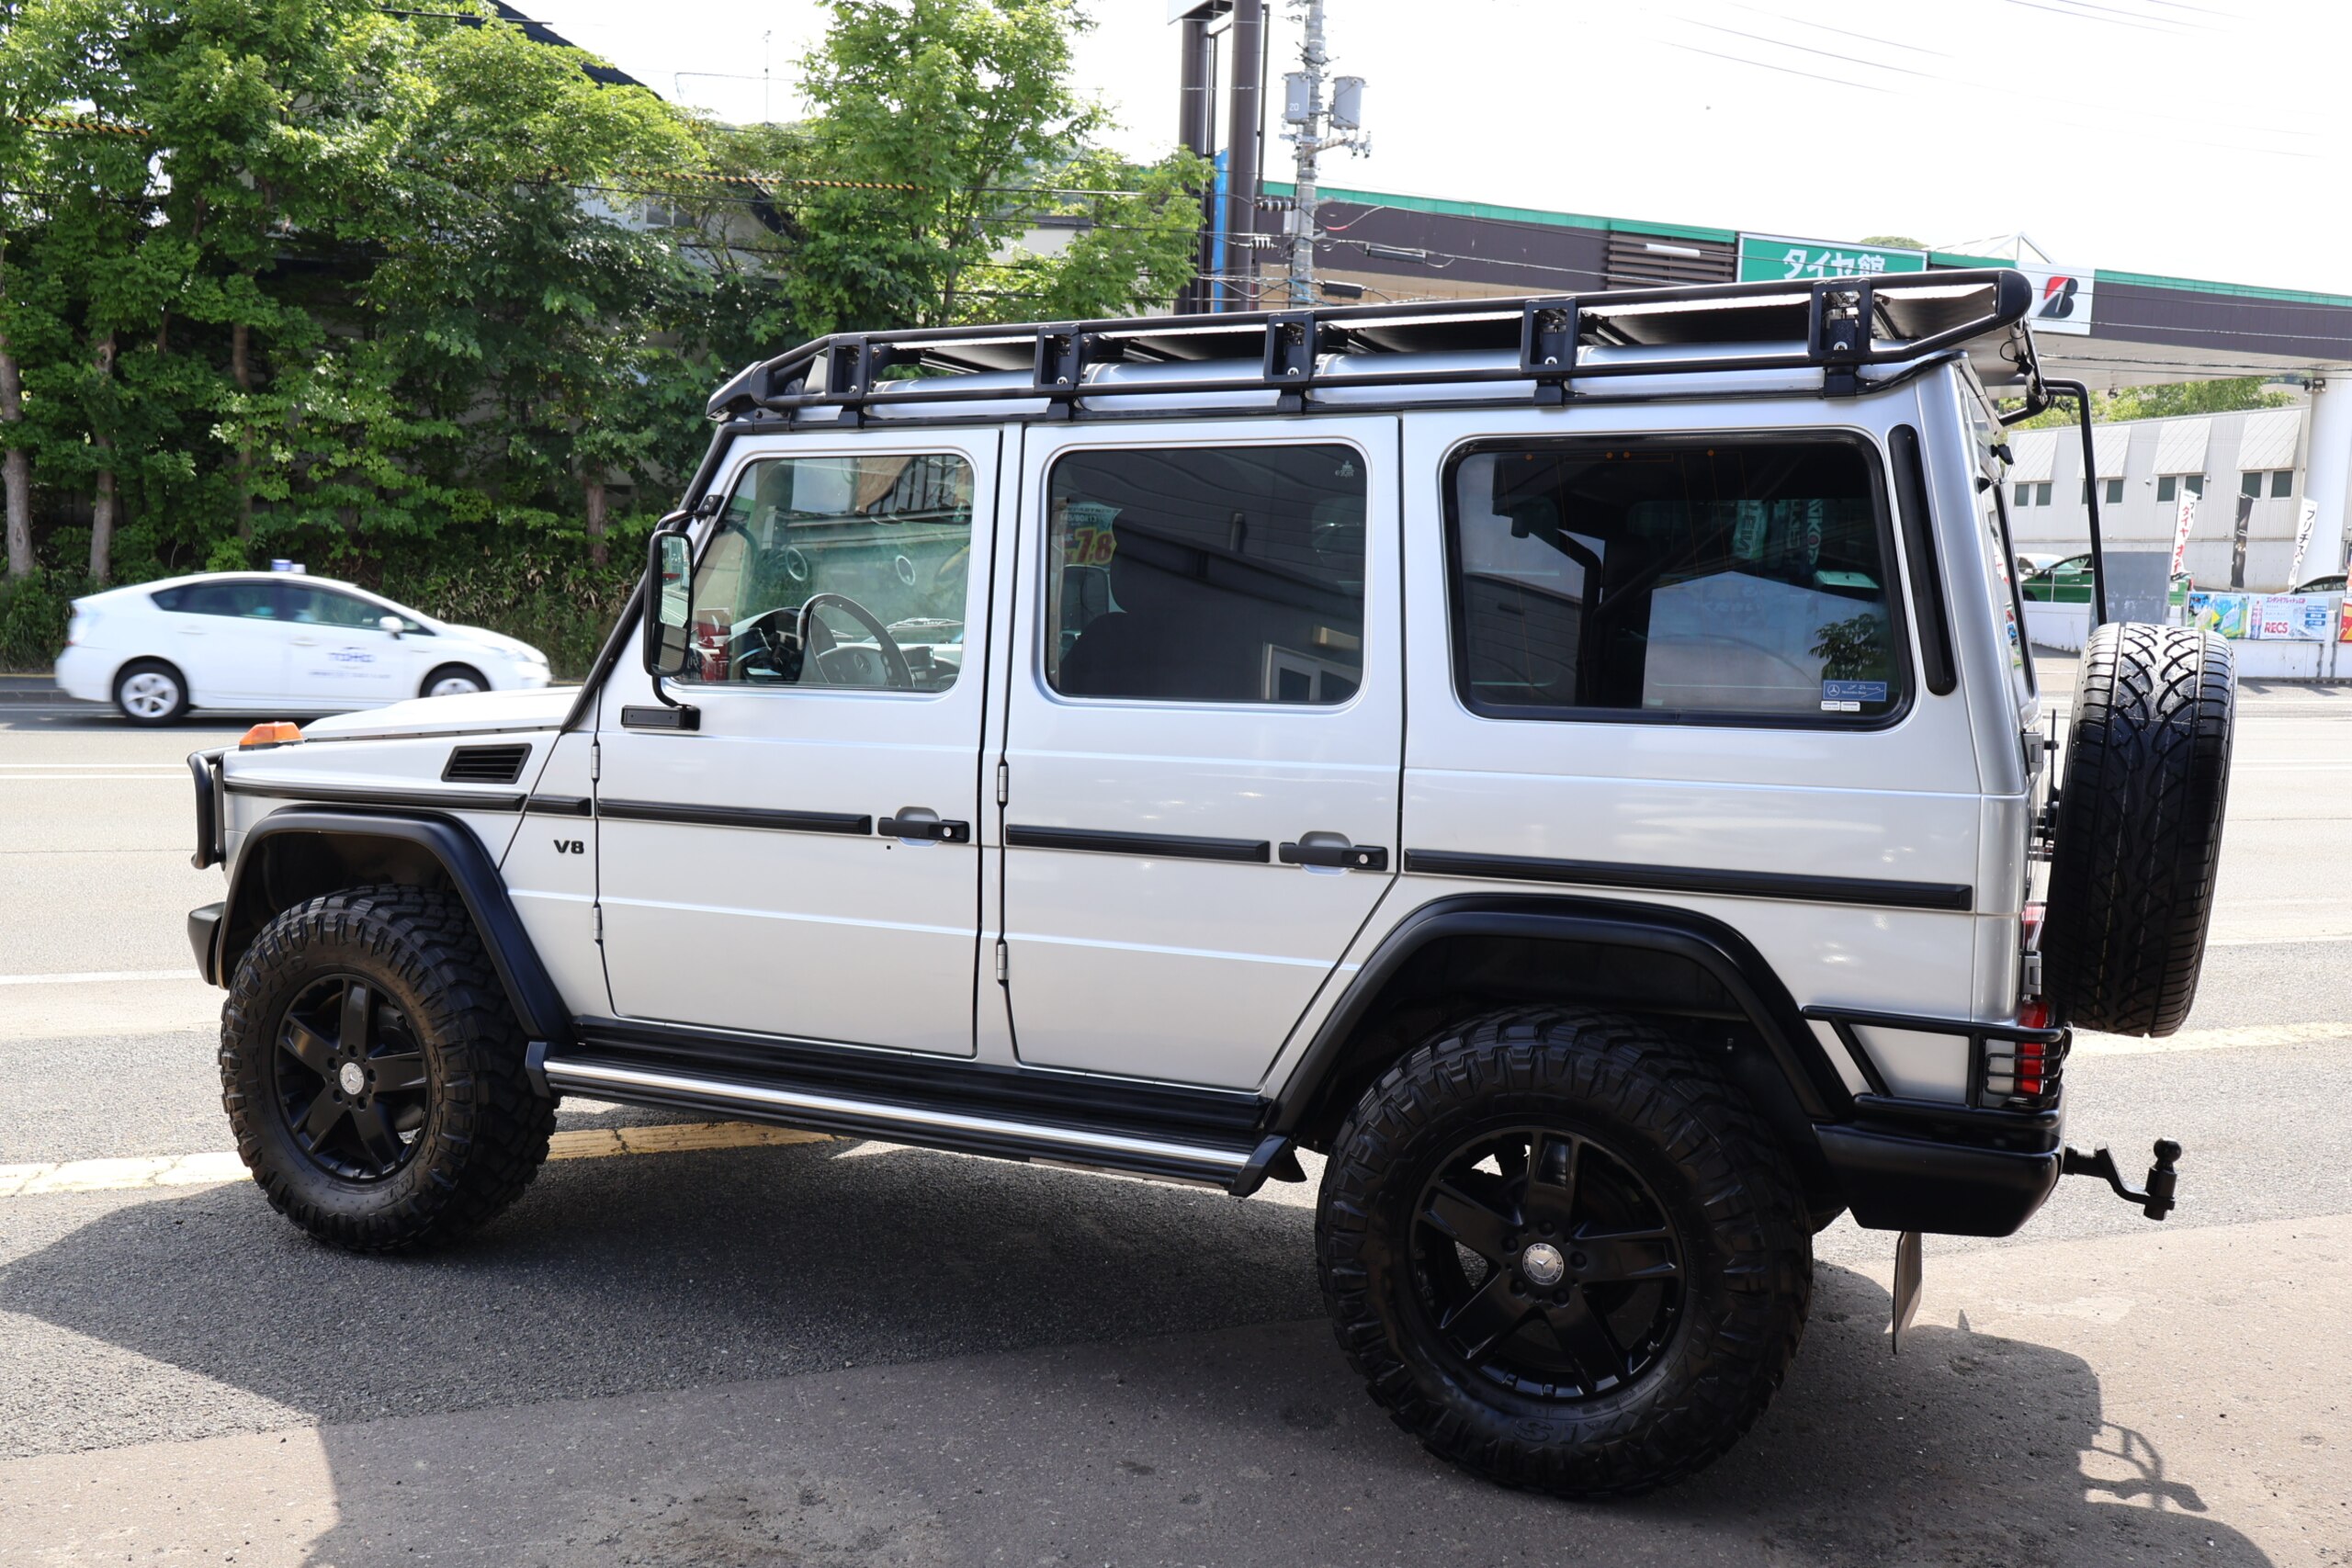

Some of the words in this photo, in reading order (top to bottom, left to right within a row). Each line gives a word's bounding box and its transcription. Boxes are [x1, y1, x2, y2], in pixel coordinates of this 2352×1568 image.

[1289, 103, 1299, 111] 20
[1782, 248, 1885, 279] タイヤ館
[2264, 622, 2289, 634] RECS
[553, 840, 584, 854] V8
